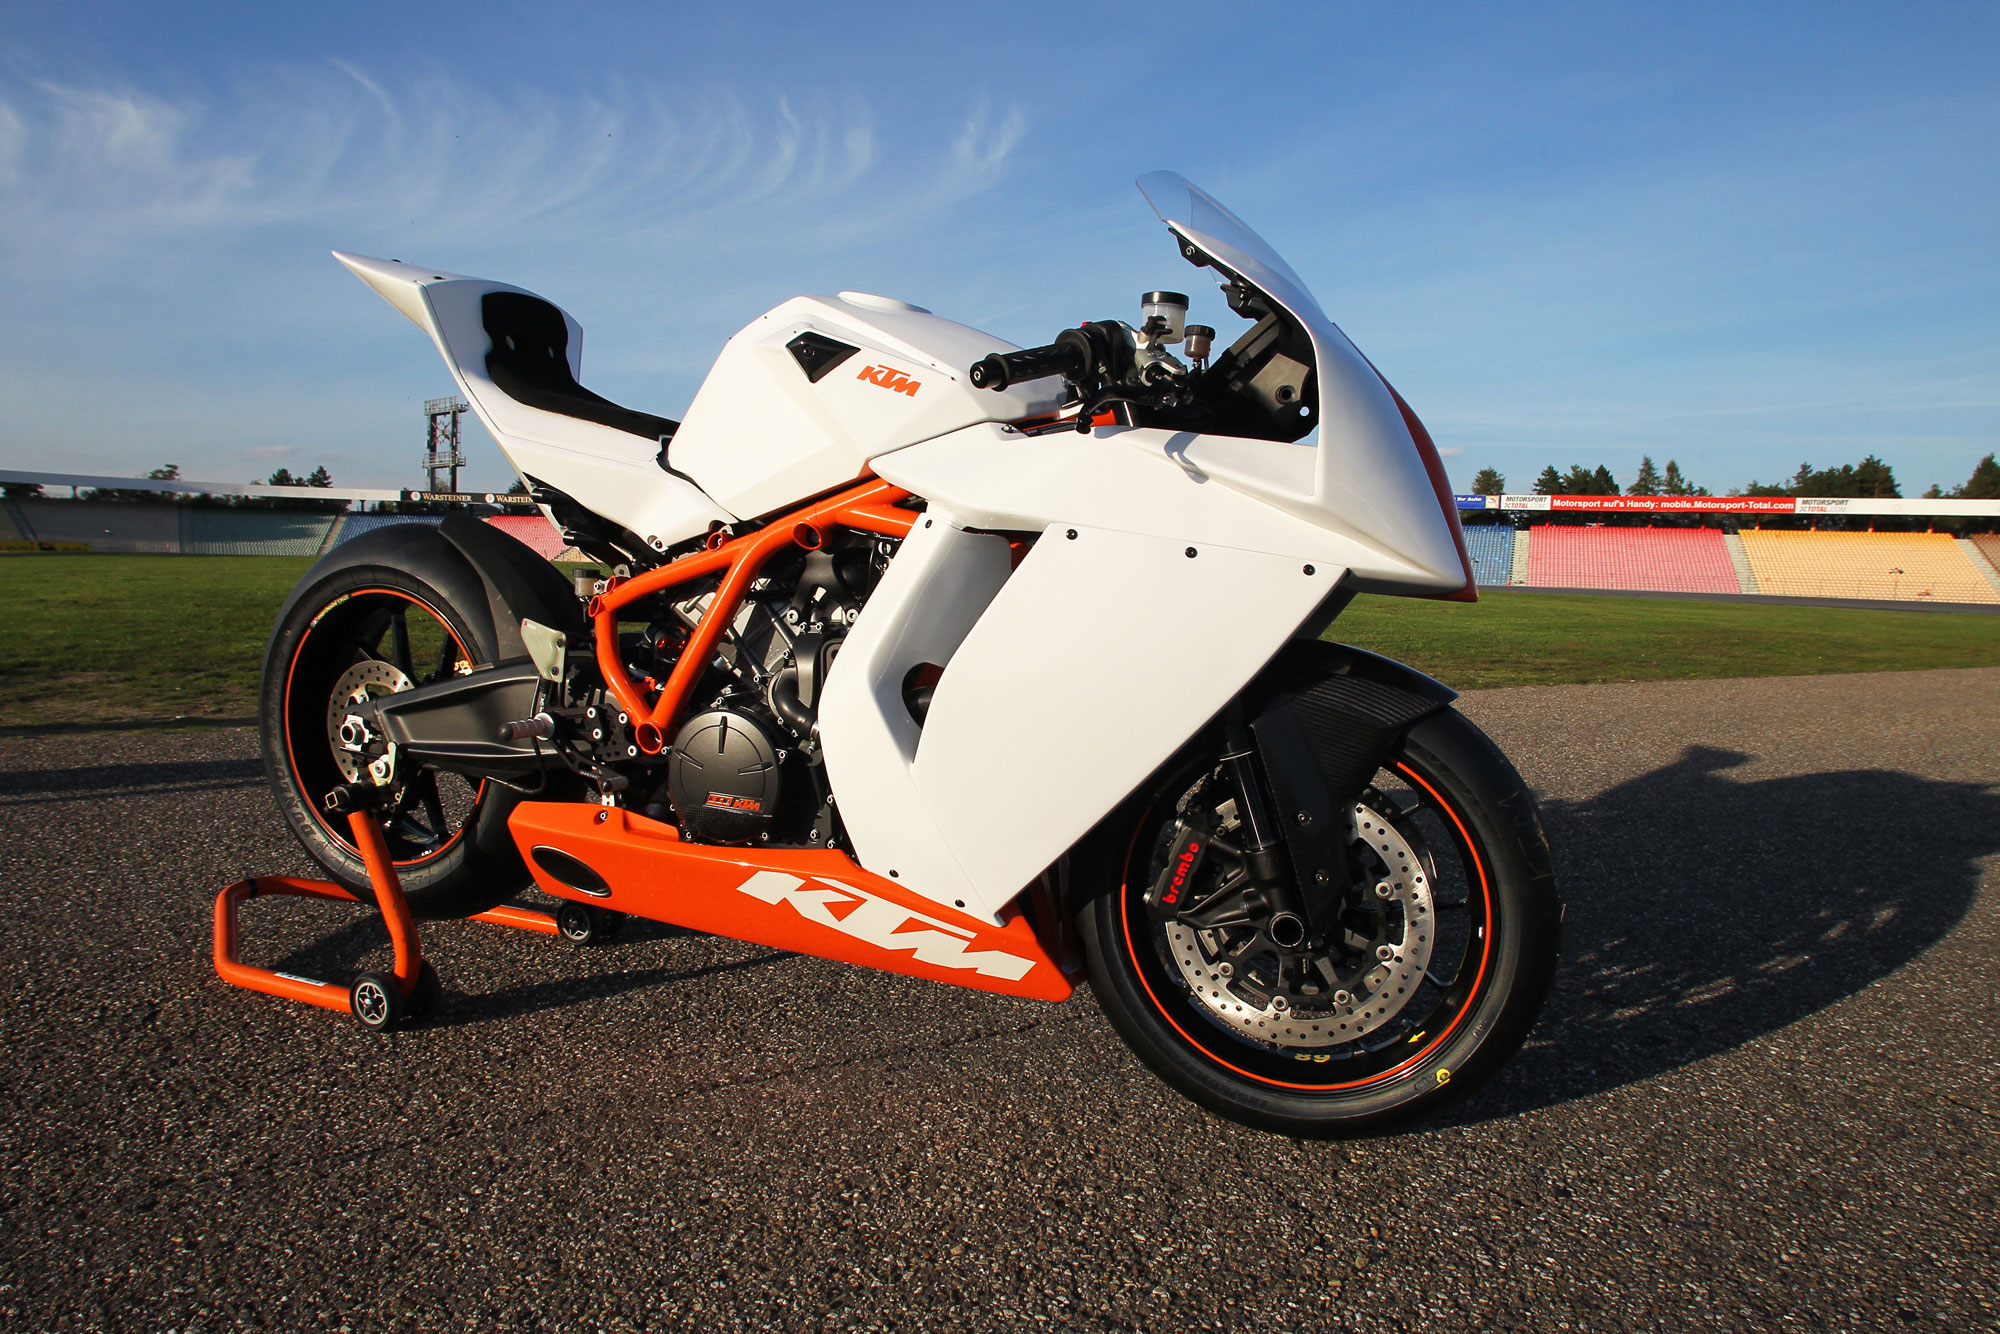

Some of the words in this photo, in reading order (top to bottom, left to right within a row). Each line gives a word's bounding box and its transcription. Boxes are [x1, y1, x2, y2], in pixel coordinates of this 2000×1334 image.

[856, 364, 922, 398] KTM
[421, 492, 472, 502] WARSTEINER
[1552, 499, 1601, 509] Motorsport
[1602, 500, 1625, 508] auf's
[1626, 500, 1659, 510] Handy:
[1660, 500, 1795, 511] mobile.Motorsport-Total.com
[733, 798, 761, 811] KTM
[1162, 842, 1200, 904] brembo
[736, 870, 1037, 982] KTM
